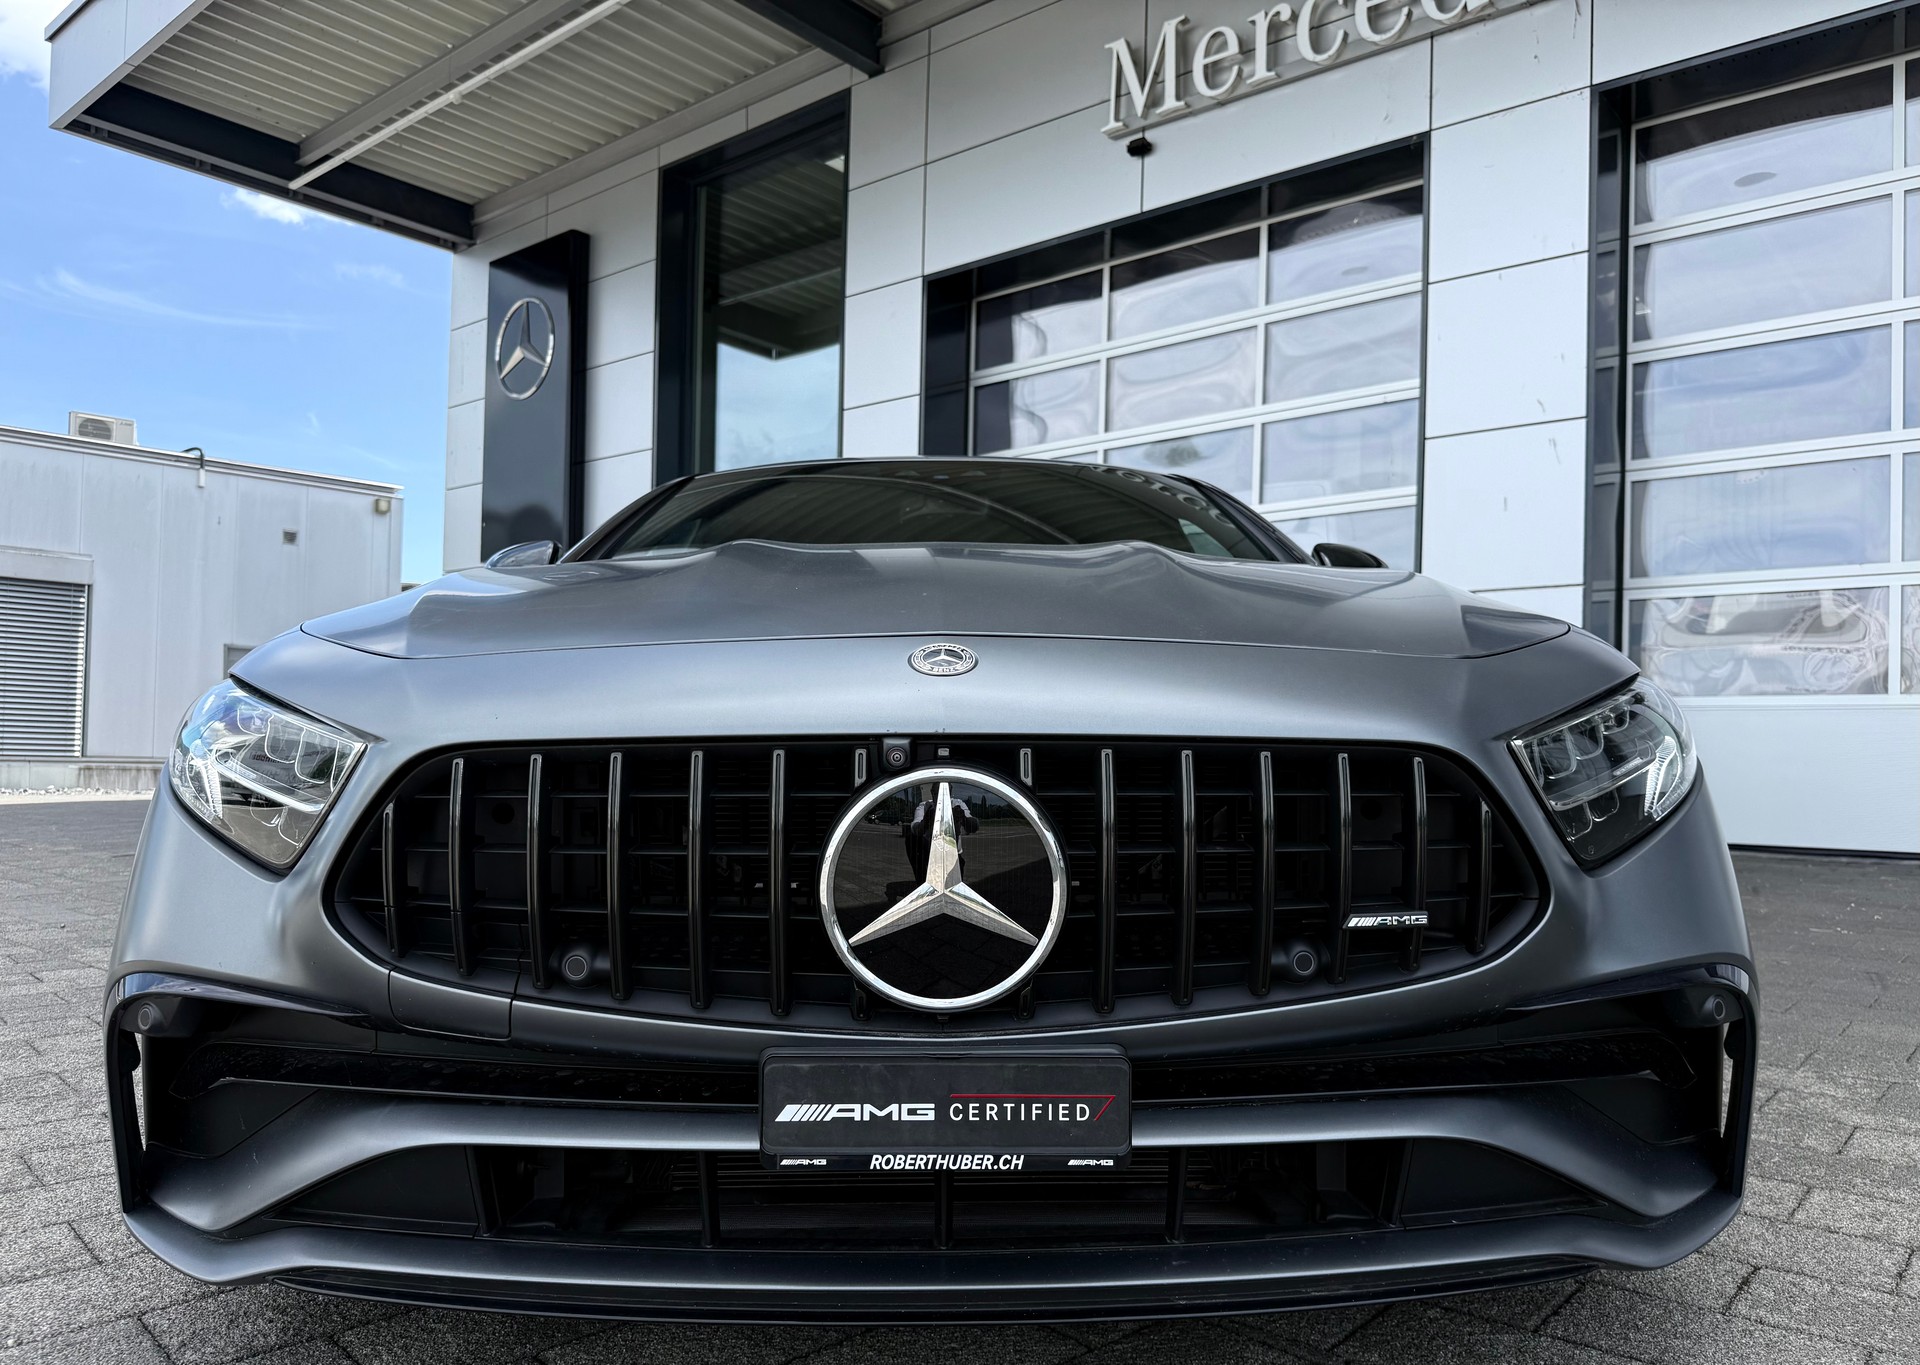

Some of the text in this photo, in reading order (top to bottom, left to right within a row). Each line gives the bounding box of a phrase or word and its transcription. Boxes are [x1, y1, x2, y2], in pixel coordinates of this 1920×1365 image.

[1101, 0, 1492, 138] Merce
[1373, 915, 1428, 926] AMG
[825, 1102, 1090, 1121] AMG CERTIFIED
[795, 1158, 827, 1166] AMG
[869, 1153, 1025, 1170] ROBERTHUBER.CH
